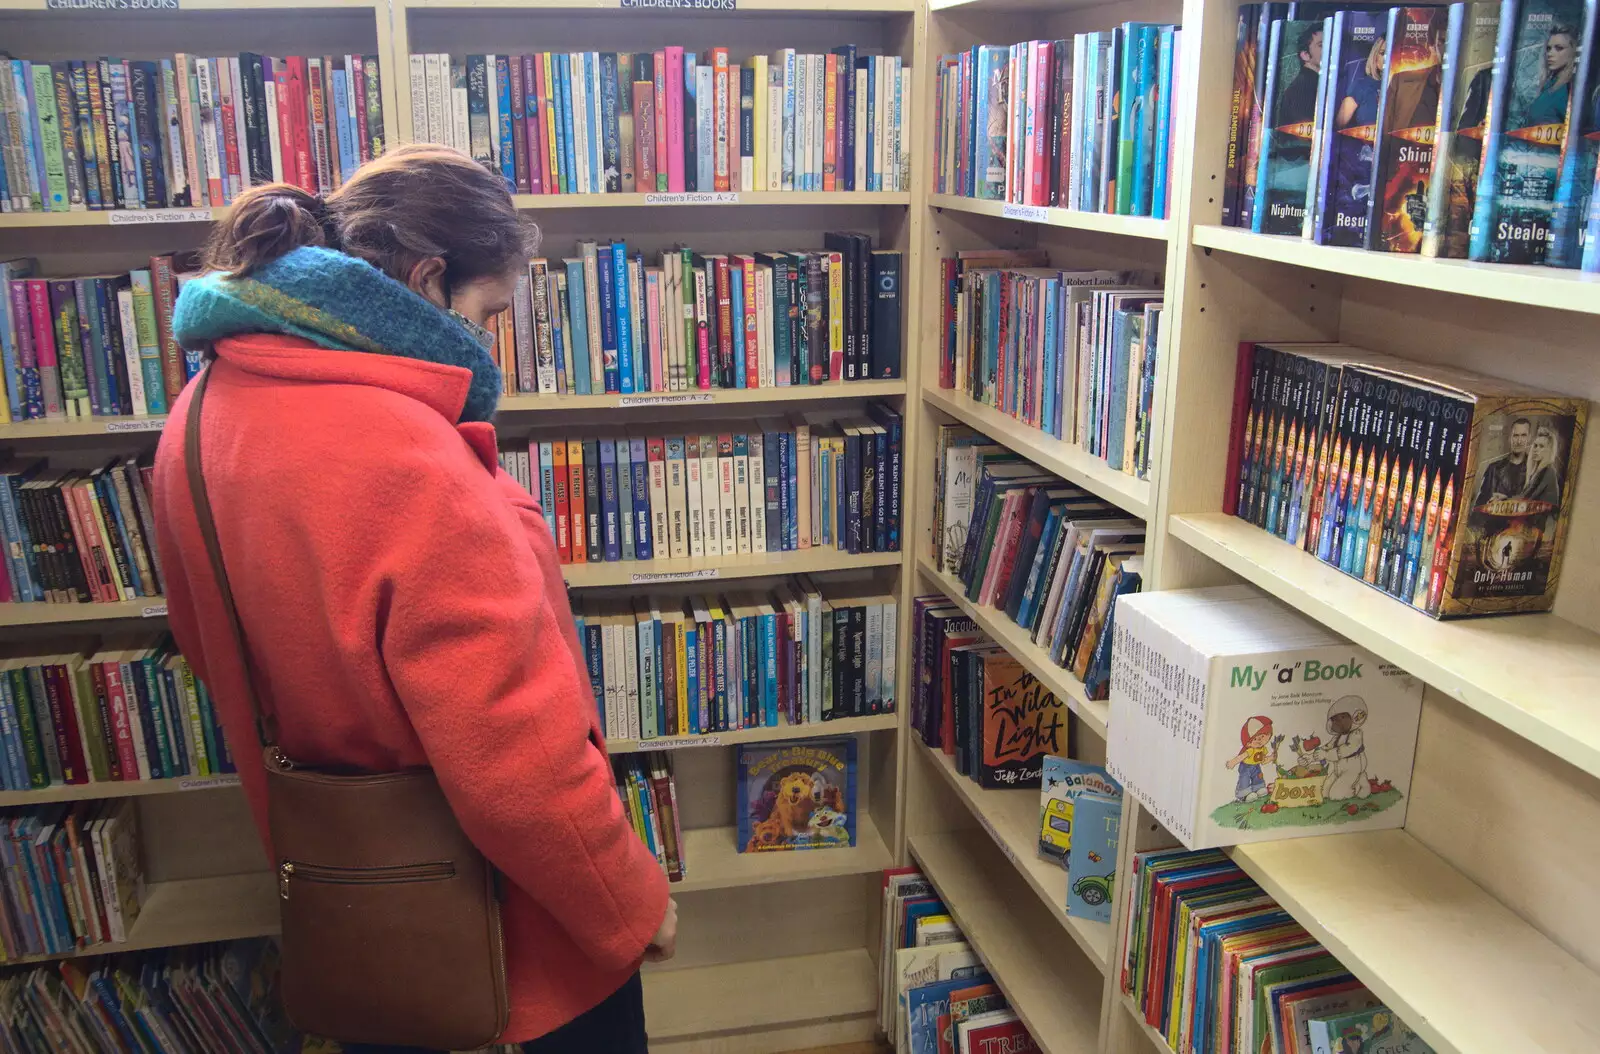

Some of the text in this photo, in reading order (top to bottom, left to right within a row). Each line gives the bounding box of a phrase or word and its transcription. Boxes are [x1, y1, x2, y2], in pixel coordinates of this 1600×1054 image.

[48, 0, 178, 10] CHILDREN'S BOOKS
[622, 0, 736, 9] CHILDREN'S BOOKS
[1526, 22, 1552, 30] BOOKS
[1528, 14, 1552, 22] BBC
[1354, 26, 1376, 34] BBC
[1406, 23, 1429, 31] BBC
[1352, 34, 1374, 42] BOOKS
[1405, 32, 1429, 40] BOOKS
[476, 63, 486, 99] Warrior
[827, 71, 835, 83] THE
[786, 88, 794, 109] Mice
[103, 87, 118, 161] David and Dorothea
[827, 112, 835, 130] BOOK
[1231, 101, 1240, 141] GLAMOUR
[1228, 140, 1236, 168] CHASE
[1399, 146, 1433, 164] Shini
[646, 193, 684, 202] Children's
[687, 192, 712, 202] Fiction
[112, 211, 210, 223] Children's Fiction A Z
[1336, 212, 1368, 228] Resu
[617, 274, 625, 286] TWO
[776, 263, 788, 299] SNATCHED!
[1066, 278, 1116, 286] Robert Louis
[618, 287, 626, 308] WORLDS
[621, 337, 629, 368] LINGARD
[622, 396, 660, 405] Children's
[662, 394, 687, 404] Fiction
[108, 422, 150, 431] Children's
[1454, 442, 1463, 466] Clockwise
[850, 490, 860, 514] Betrayal
[1490, 502, 1518, 514] DOCTOR
[632, 572, 668, 580] Children's
[1474, 570, 1532, 584] Only Human
[838, 624, 848, 662] Northern Lights
[853, 632, 863, 654] Northern
[688, 646, 696, 678] DAVE PELZER
[716, 654, 724, 675] FREDDIE
[852, 655, 862, 669] Lights
[1230, 666, 1268, 692] My
[1302, 658, 1364, 682] Book
[853, 678, 862, 692] Philip
[618, 695, 626, 710] Joan
[989, 681, 1018, 708] In
[993, 690, 1062, 726] Wild
[187, 690, 206, 759] JACK HEATH
[994, 710, 1063, 759] Light
[640, 740, 674, 748] Children's
[674, 738, 698, 746] Fiction
[770, 757, 829, 773] Treasury
[792, 746, 815, 758] Big
[816, 750, 845, 772] Blue
[994, 768, 1018, 782] Jeff
[1275, 781, 1316, 800] box
